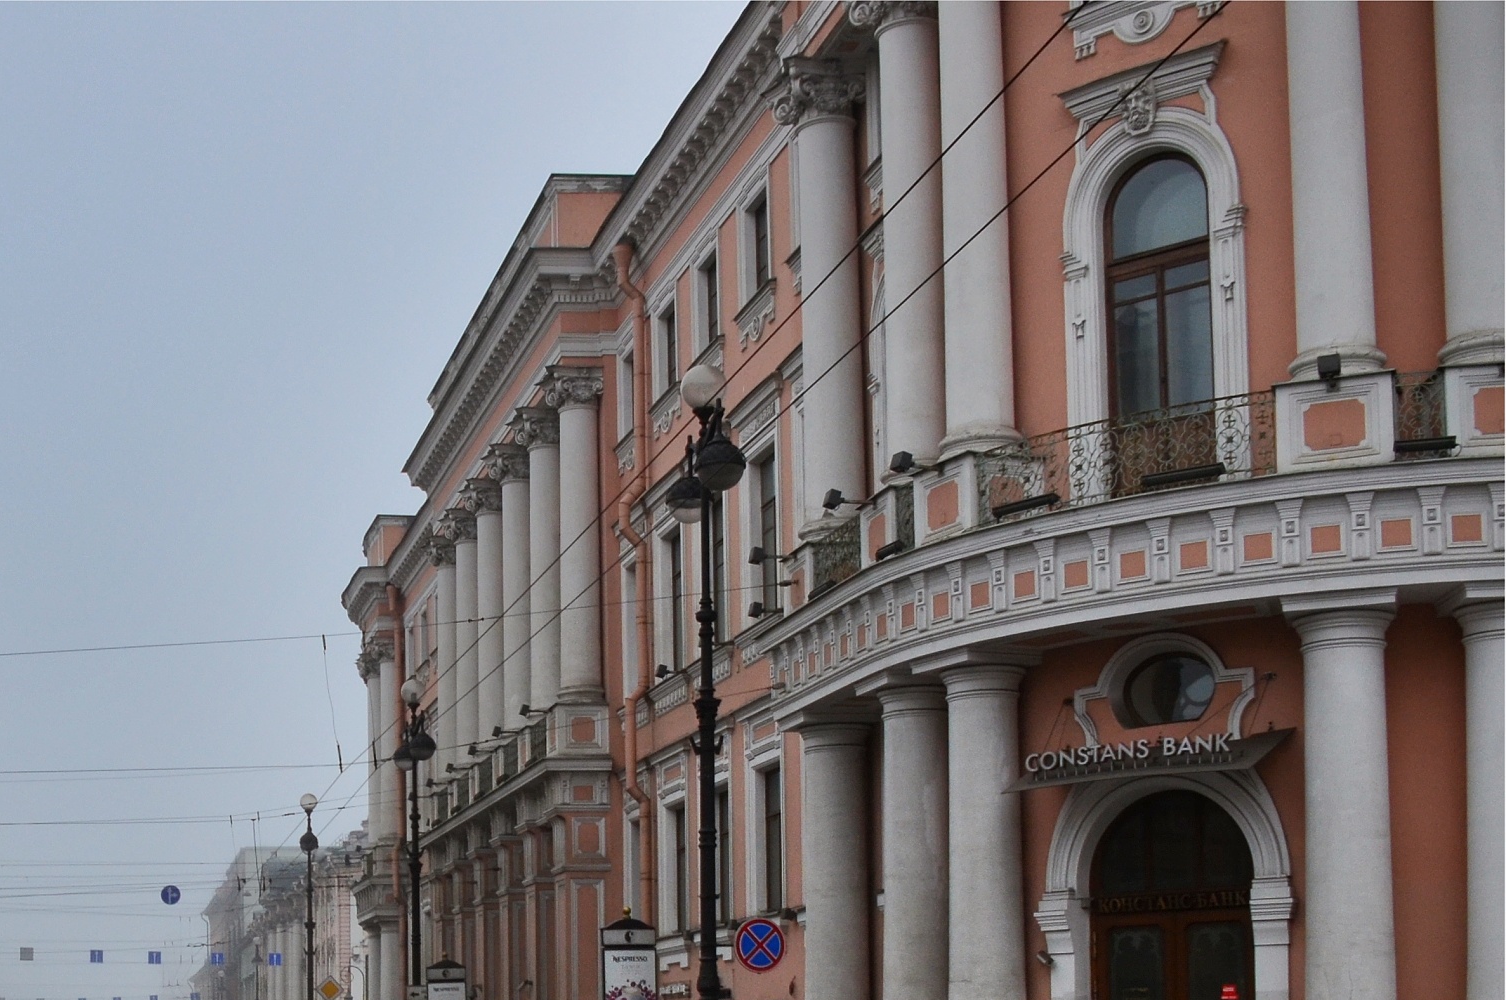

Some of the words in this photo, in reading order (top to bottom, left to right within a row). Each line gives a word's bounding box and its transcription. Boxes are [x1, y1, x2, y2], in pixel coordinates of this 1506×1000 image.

[1025, 738, 1149, 772] CONSTANS
[1163, 732, 1233, 756] BANK
[612, 955, 648, 963] NESPRESSO
